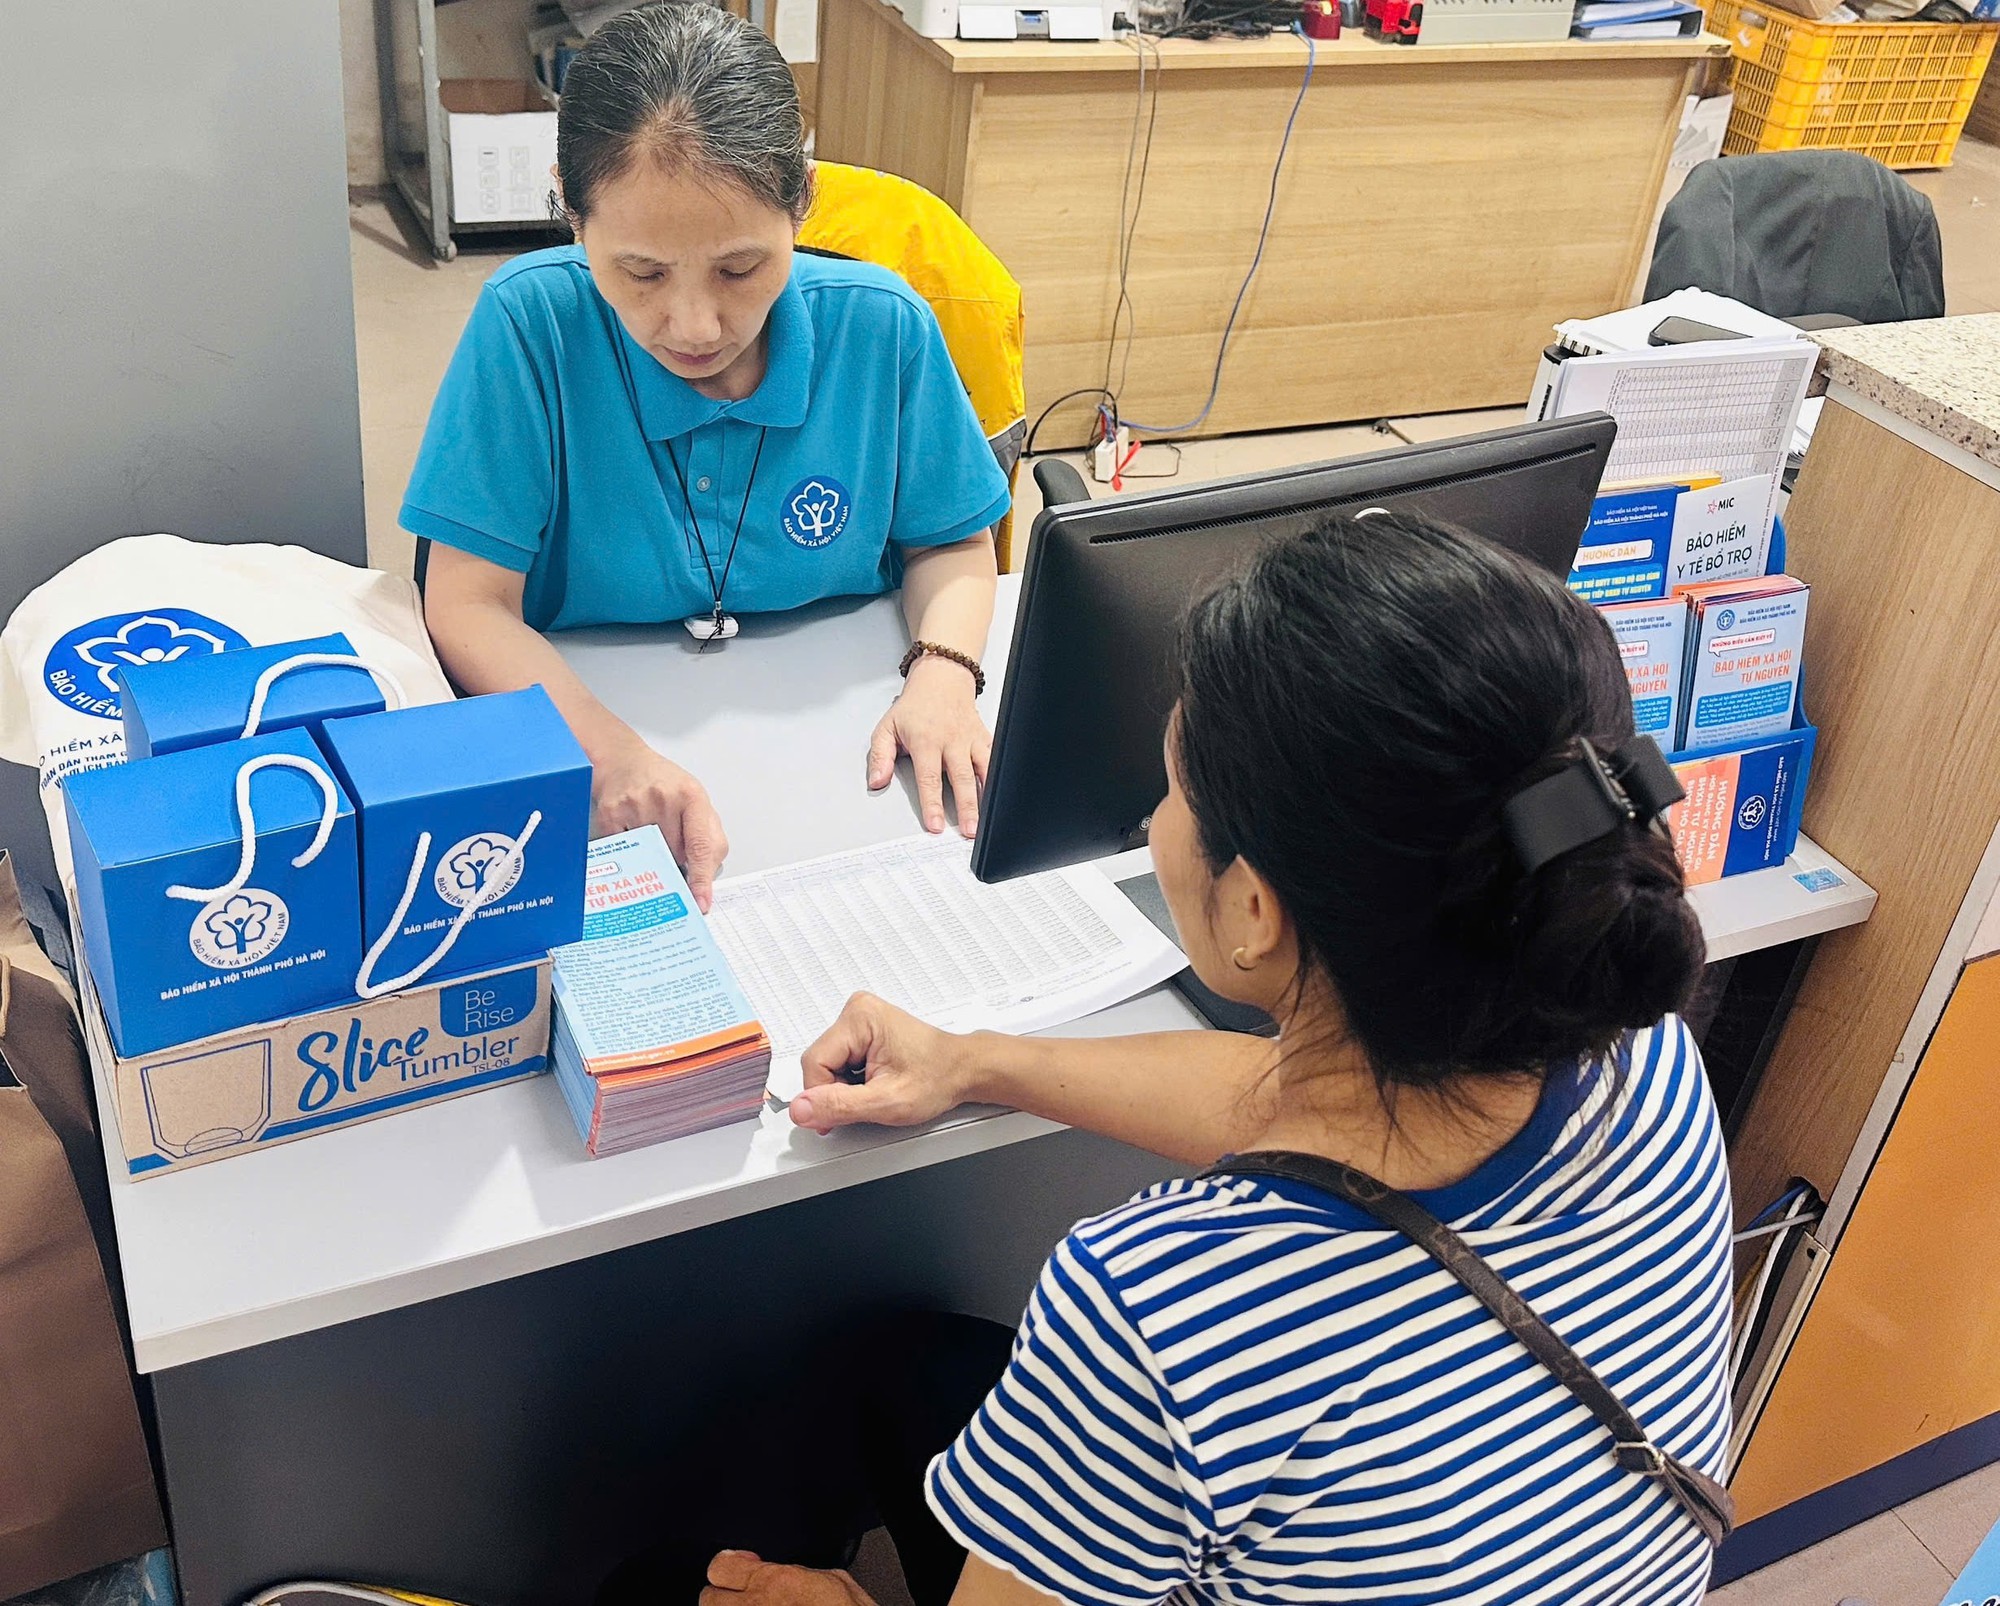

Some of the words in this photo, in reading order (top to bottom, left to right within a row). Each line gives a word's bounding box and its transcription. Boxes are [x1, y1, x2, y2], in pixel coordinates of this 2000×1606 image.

[1718, 497, 1735, 511] MIC
[784, 517, 793, 533] BẢO
[1686, 531, 1713, 553] BẢO
[1716, 520, 1746, 544] HIỂM
[1677, 564, 1685, 579] Y
[1689, 554, 1705, 576] TẾ
[1705, 548, 1724, 571] BỔ
[1727, 545, 1753, 565] TRỢ
[49, 669, 76, 696] BẢO
[70, 691, 122, 718] HIỂM
[50, 738, 92, 756] HIỂM
[85, 752, 116, 762] THAM
[585, 882, 610, 897] ỂM
[587, 896, 606, 909] TỰ
[609, 882, 665, 904] NGUYỆN
[404, 924, 421, 935] BẢO
[423, 917, 446, 931] HIỂM
[478, 905, 506, 919] THÀNH
[507, 900, 524, 912] PHỐ
[526, 898, 538, 908] HÀ
[539, 896, 554, 906] NỘI
[160, 988, 180, 1000] BẢO
[182, 981, 207, 995] HIỂM
[224, 973, 240, 984] HỘI
[241, 964, 272, 979] THÀNH
[274, 956, 294, 971] PHỐ
[296, 952, 308, 965] HÀ
[310, 949, 326, 961] NỘI
[464, 989, 496, 1011] Be
[464, 1006, 514, 1032] Rise
[297, 1017, 430, 1112] Slice
[392, 1036, 520, 1082] Tumbler
[472, 1057, 511, 1074] TSL-08
